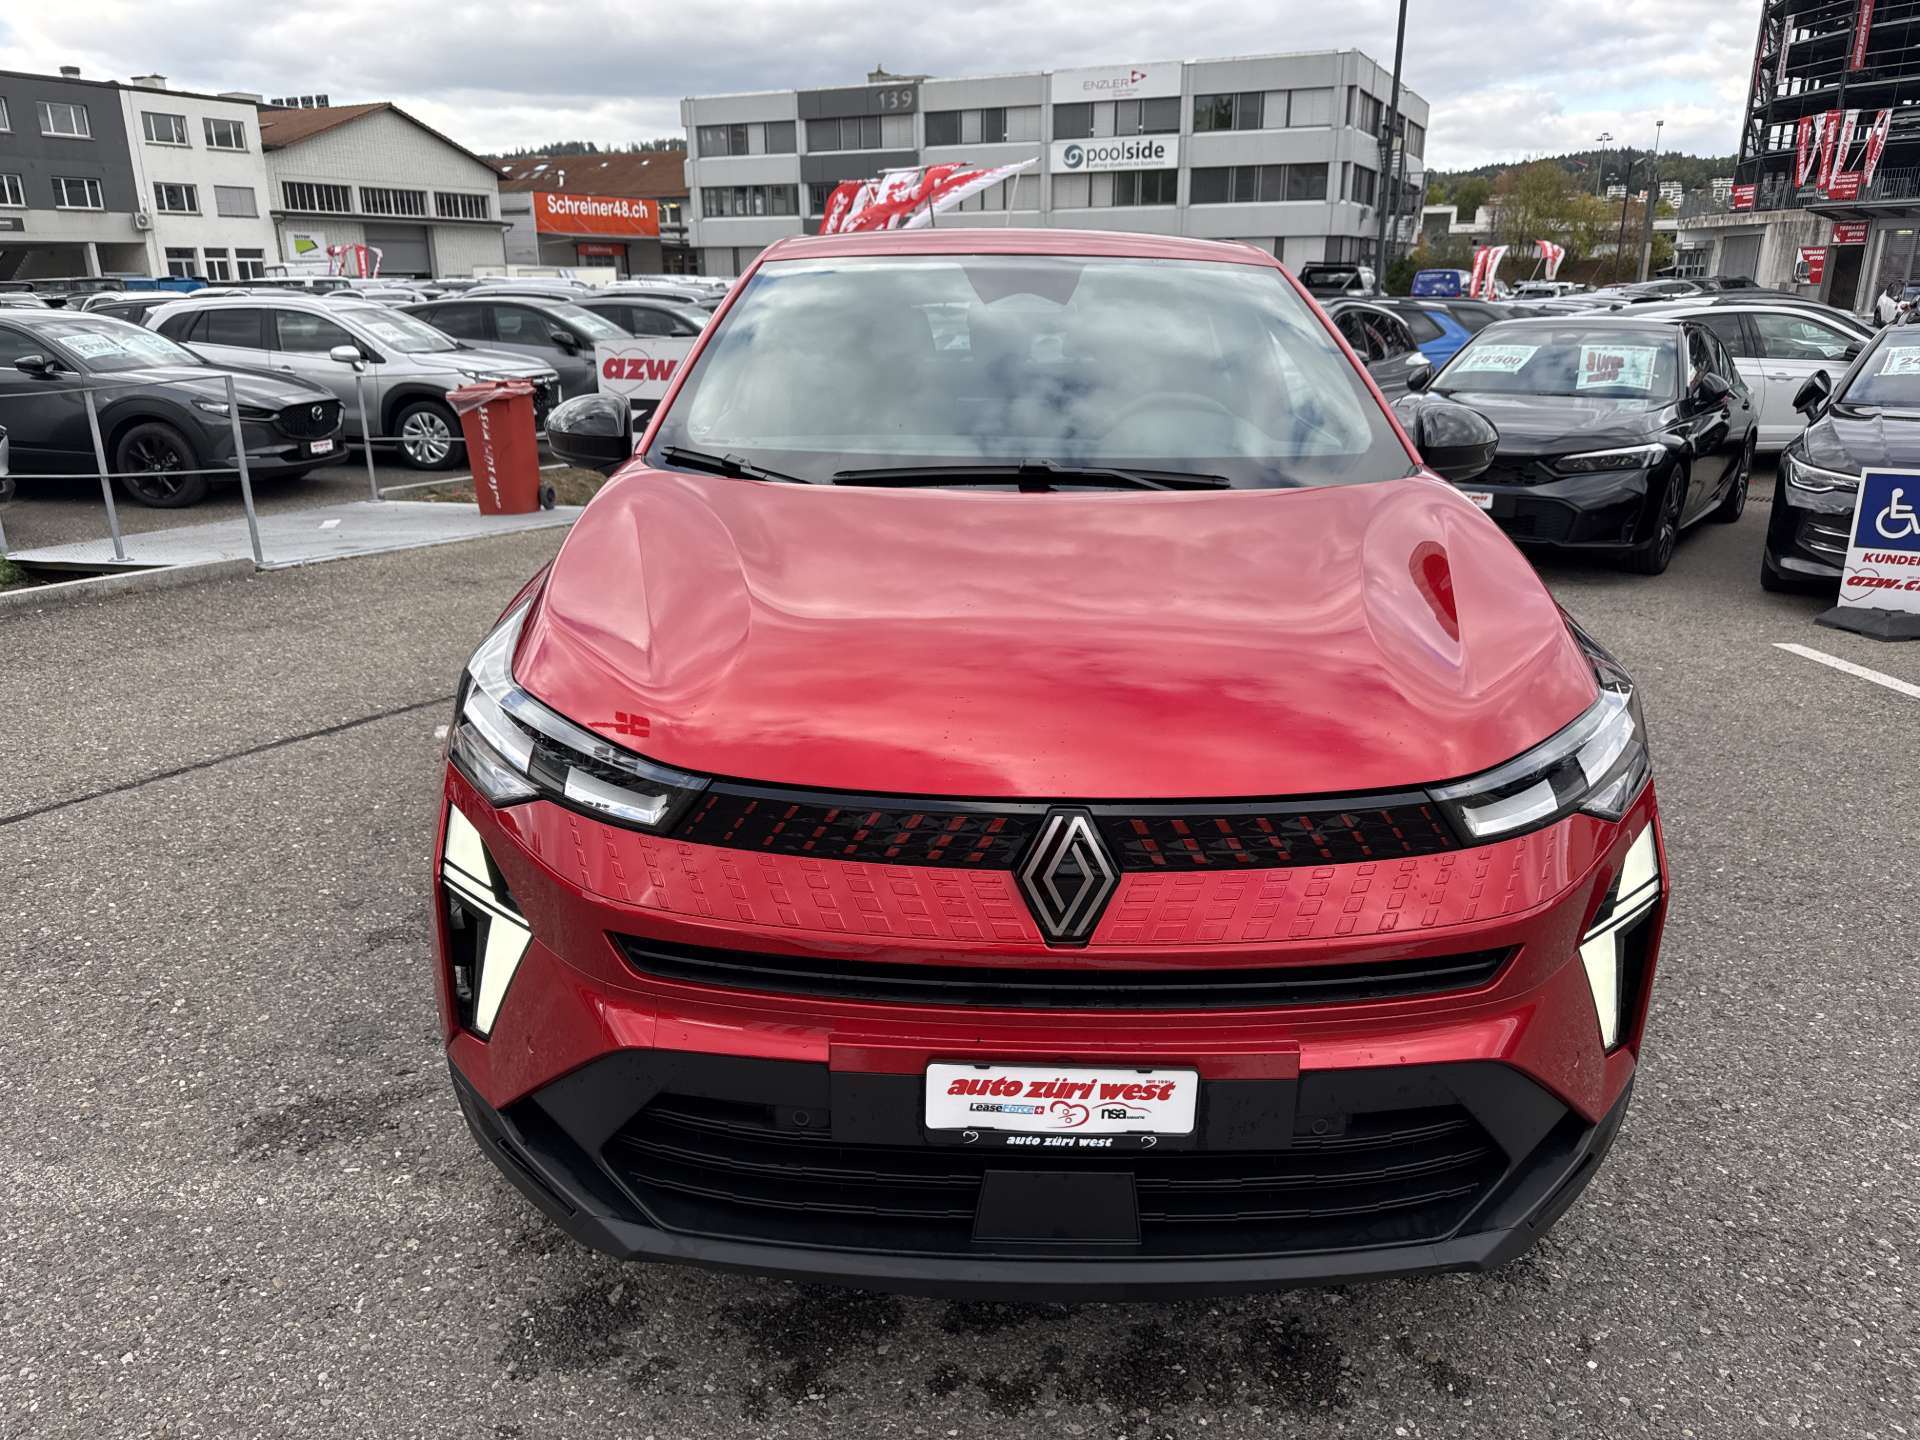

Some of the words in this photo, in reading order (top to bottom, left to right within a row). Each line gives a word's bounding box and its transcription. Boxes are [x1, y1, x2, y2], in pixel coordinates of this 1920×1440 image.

[1083, 79, 1129, 90] ENZLER
[879, 90, 912, 109] 139
[1086, 140, 1165, 168] poolside
[547, 194, 649, 218] Schreiner48.ch
[947, 1076, 1023, 1097] auto
[1023, 1078, 1098, 1100] züri
[1099, 1081, 1176, 1101] west
[1101, 1109, 1126, 1119] nsa
[1006, 1136, 1041, 1146] auto
[1043, 1136, 1076, 1147] züri
[1079, 1138, 1112, 1147] west
